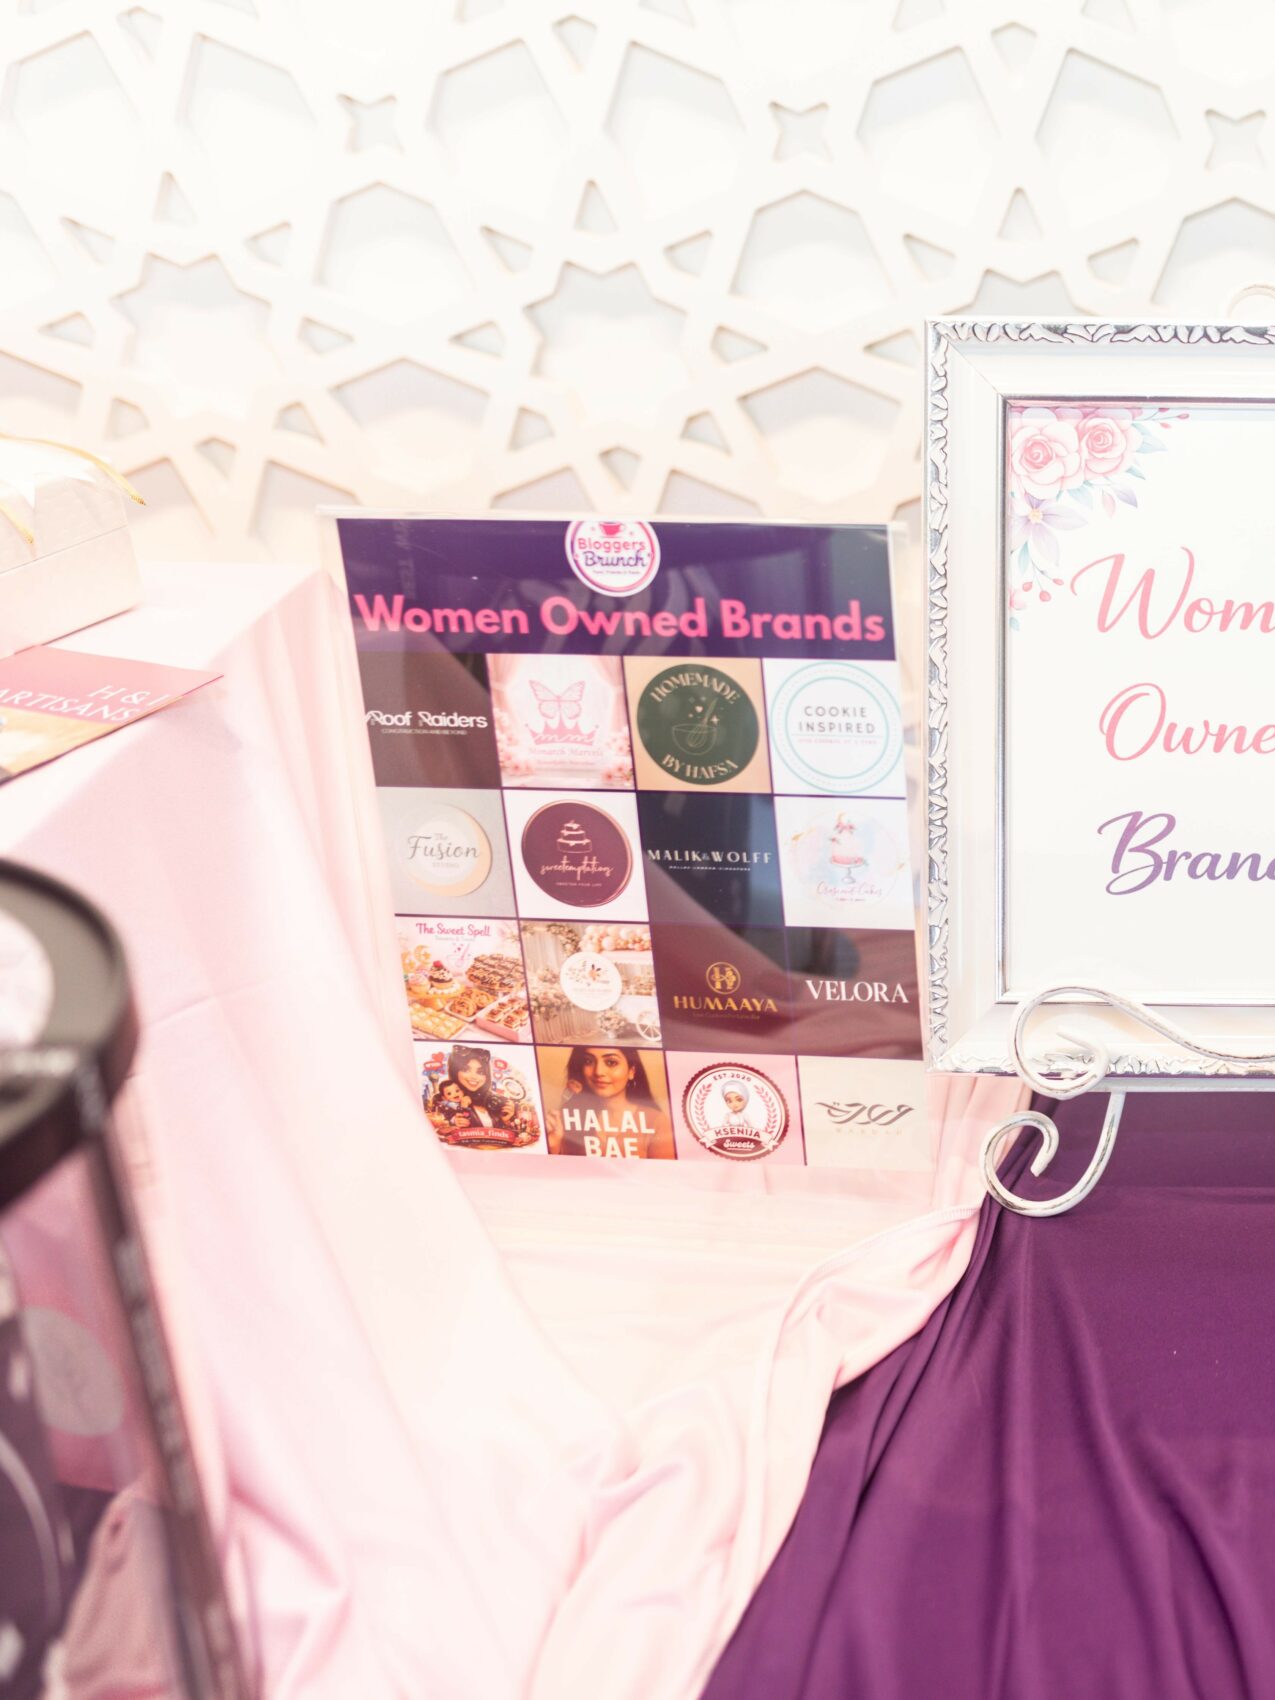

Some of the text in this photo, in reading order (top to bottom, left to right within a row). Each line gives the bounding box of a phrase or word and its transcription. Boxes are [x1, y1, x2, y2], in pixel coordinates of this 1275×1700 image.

[578, 537, 646, 553] Bloggers
[582, 549, 647, 567] Brunch
[353, 594, 886, 642] Women Owned Brands
[88, 684, 126, 700] H
[650, 671, 740, 704] HOMEMADE
[367, 710, 489, 728] Roof Raiders
[804, 705, 867, 718] COOKIE
[799, 721, 875, 734] INSPIRED
[661, 753, 739, 780] BY HAFSA
[407, 835, 480, 860] Fusion
[415, 922, 492, 937] The Sweet Spell
[805, 979, 910, 1003] VELORA
[673, 995, 778, 1013] HUMAAYA
[562, 1107, 656, 1134] HALAL
[714, 1127, 761, 1139] KSENIJA
[583, 1135, 640, 1160] BAE
